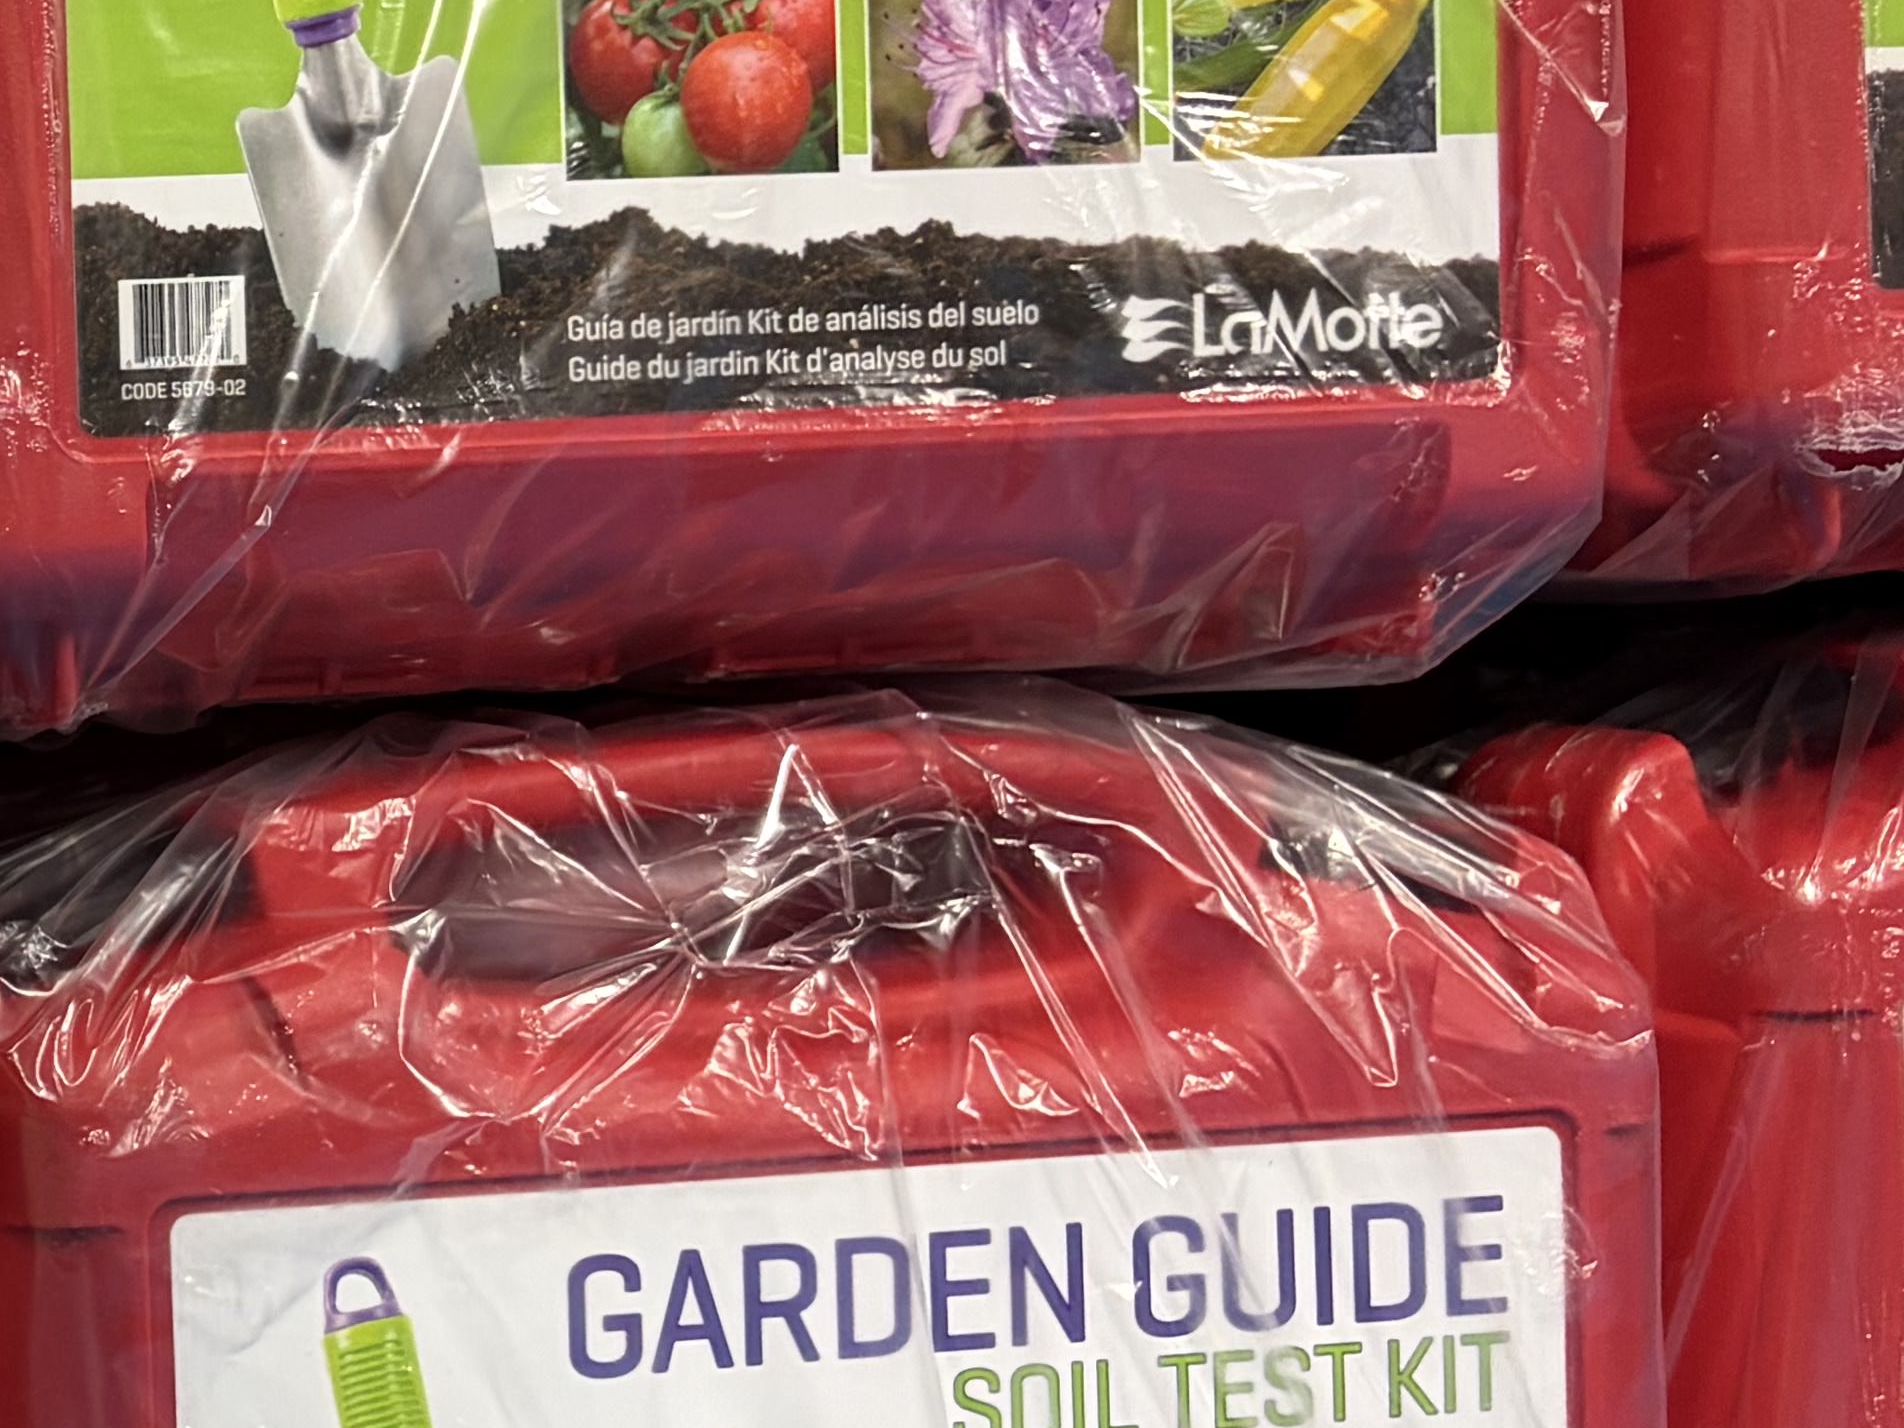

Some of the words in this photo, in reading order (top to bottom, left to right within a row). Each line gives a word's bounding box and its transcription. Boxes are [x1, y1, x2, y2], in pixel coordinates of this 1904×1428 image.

[568, 313, 624, 342] Guía
[631, 312, 661, 339] de
[666, 308, 741, 344] jardín
[748, 308, 782, 335] Kit
[788, 306, 819, 332] de
[826, 303, 922, 332] análisis
[929, 301, 965, 327] del
[973, 298, 1040, 326] suelo
[1193, 287, 1443, 356] LaMotte
[121, 382, 167, 400] CODE
[171, 379, 246, 397] 5679-02
[568, 352, 641, 383] Guide
[648, 351, 679, 378] du
[685, 348, 758, 384] jardin
[766, 347, 799, 374] Kit
[806, 343, 925, 376] d'analyse
[932, 341, 963, 367] du
[970, 339, 1007, 367] sol
[568, 1220, 1086, 1380] GARDEN
[1132, 1195, 1510, 1340] GUIDE
[1388, 1333, 1511, 1418] KIT
